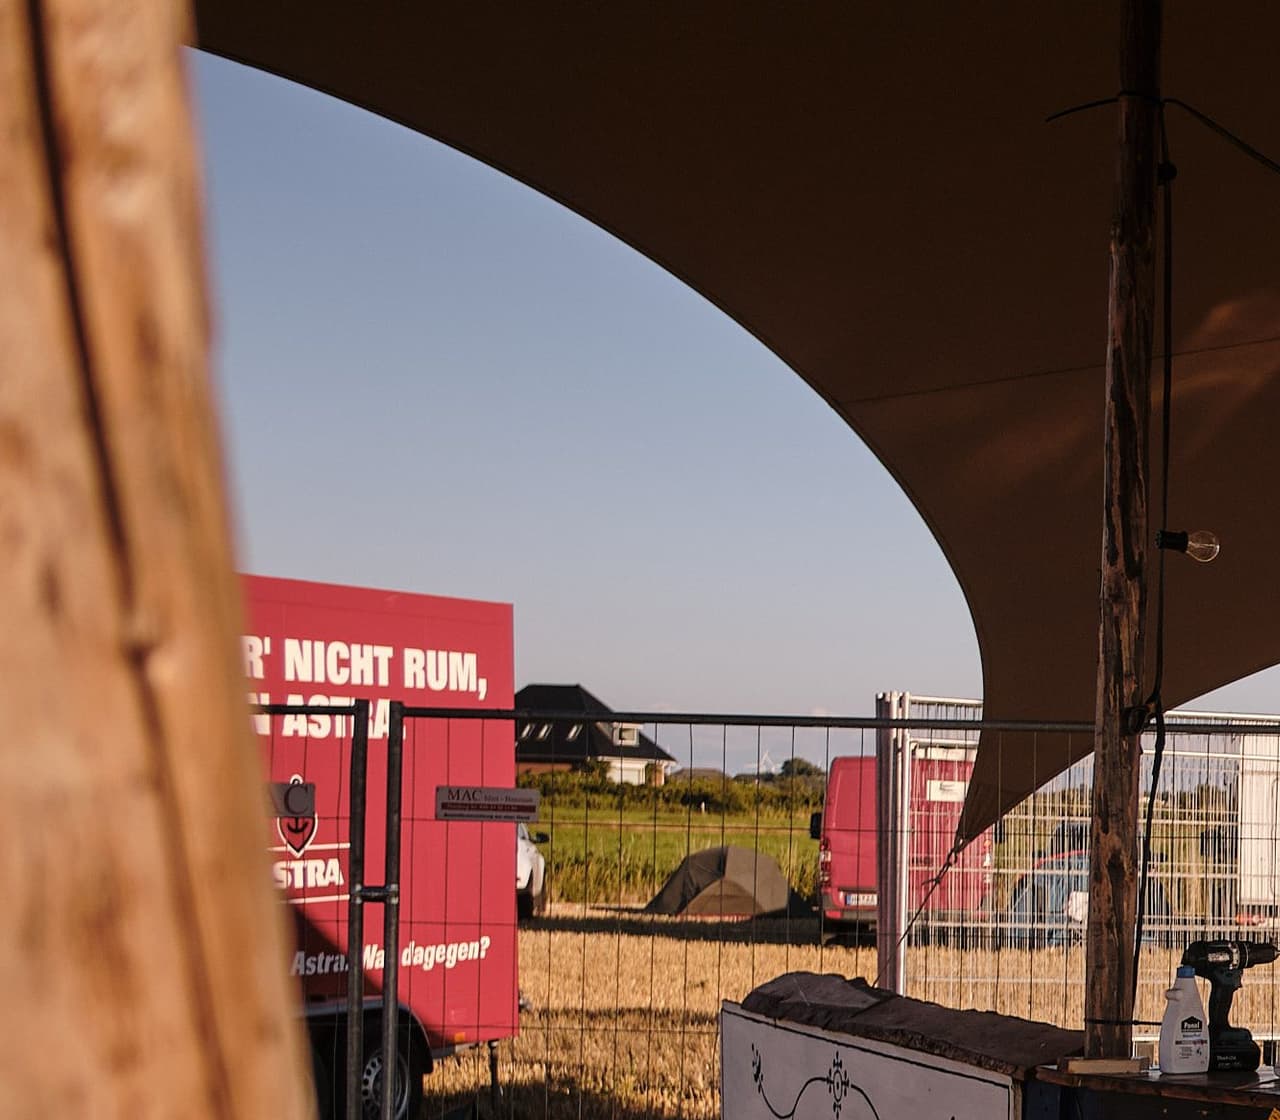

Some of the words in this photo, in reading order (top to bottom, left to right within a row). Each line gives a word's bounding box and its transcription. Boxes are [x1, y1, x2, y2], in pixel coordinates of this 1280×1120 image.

[284, 638, 394, 687] NICHT
[403, 648, 488, 701] RUM,
[447, 789, 482, 802] MAC
[272, 858, 345, 890] STRA
[290, 951, 349, 976] Astra.
[362, 943, 385, 970] Wa
[401, 936, 490, 971] dagegen?
